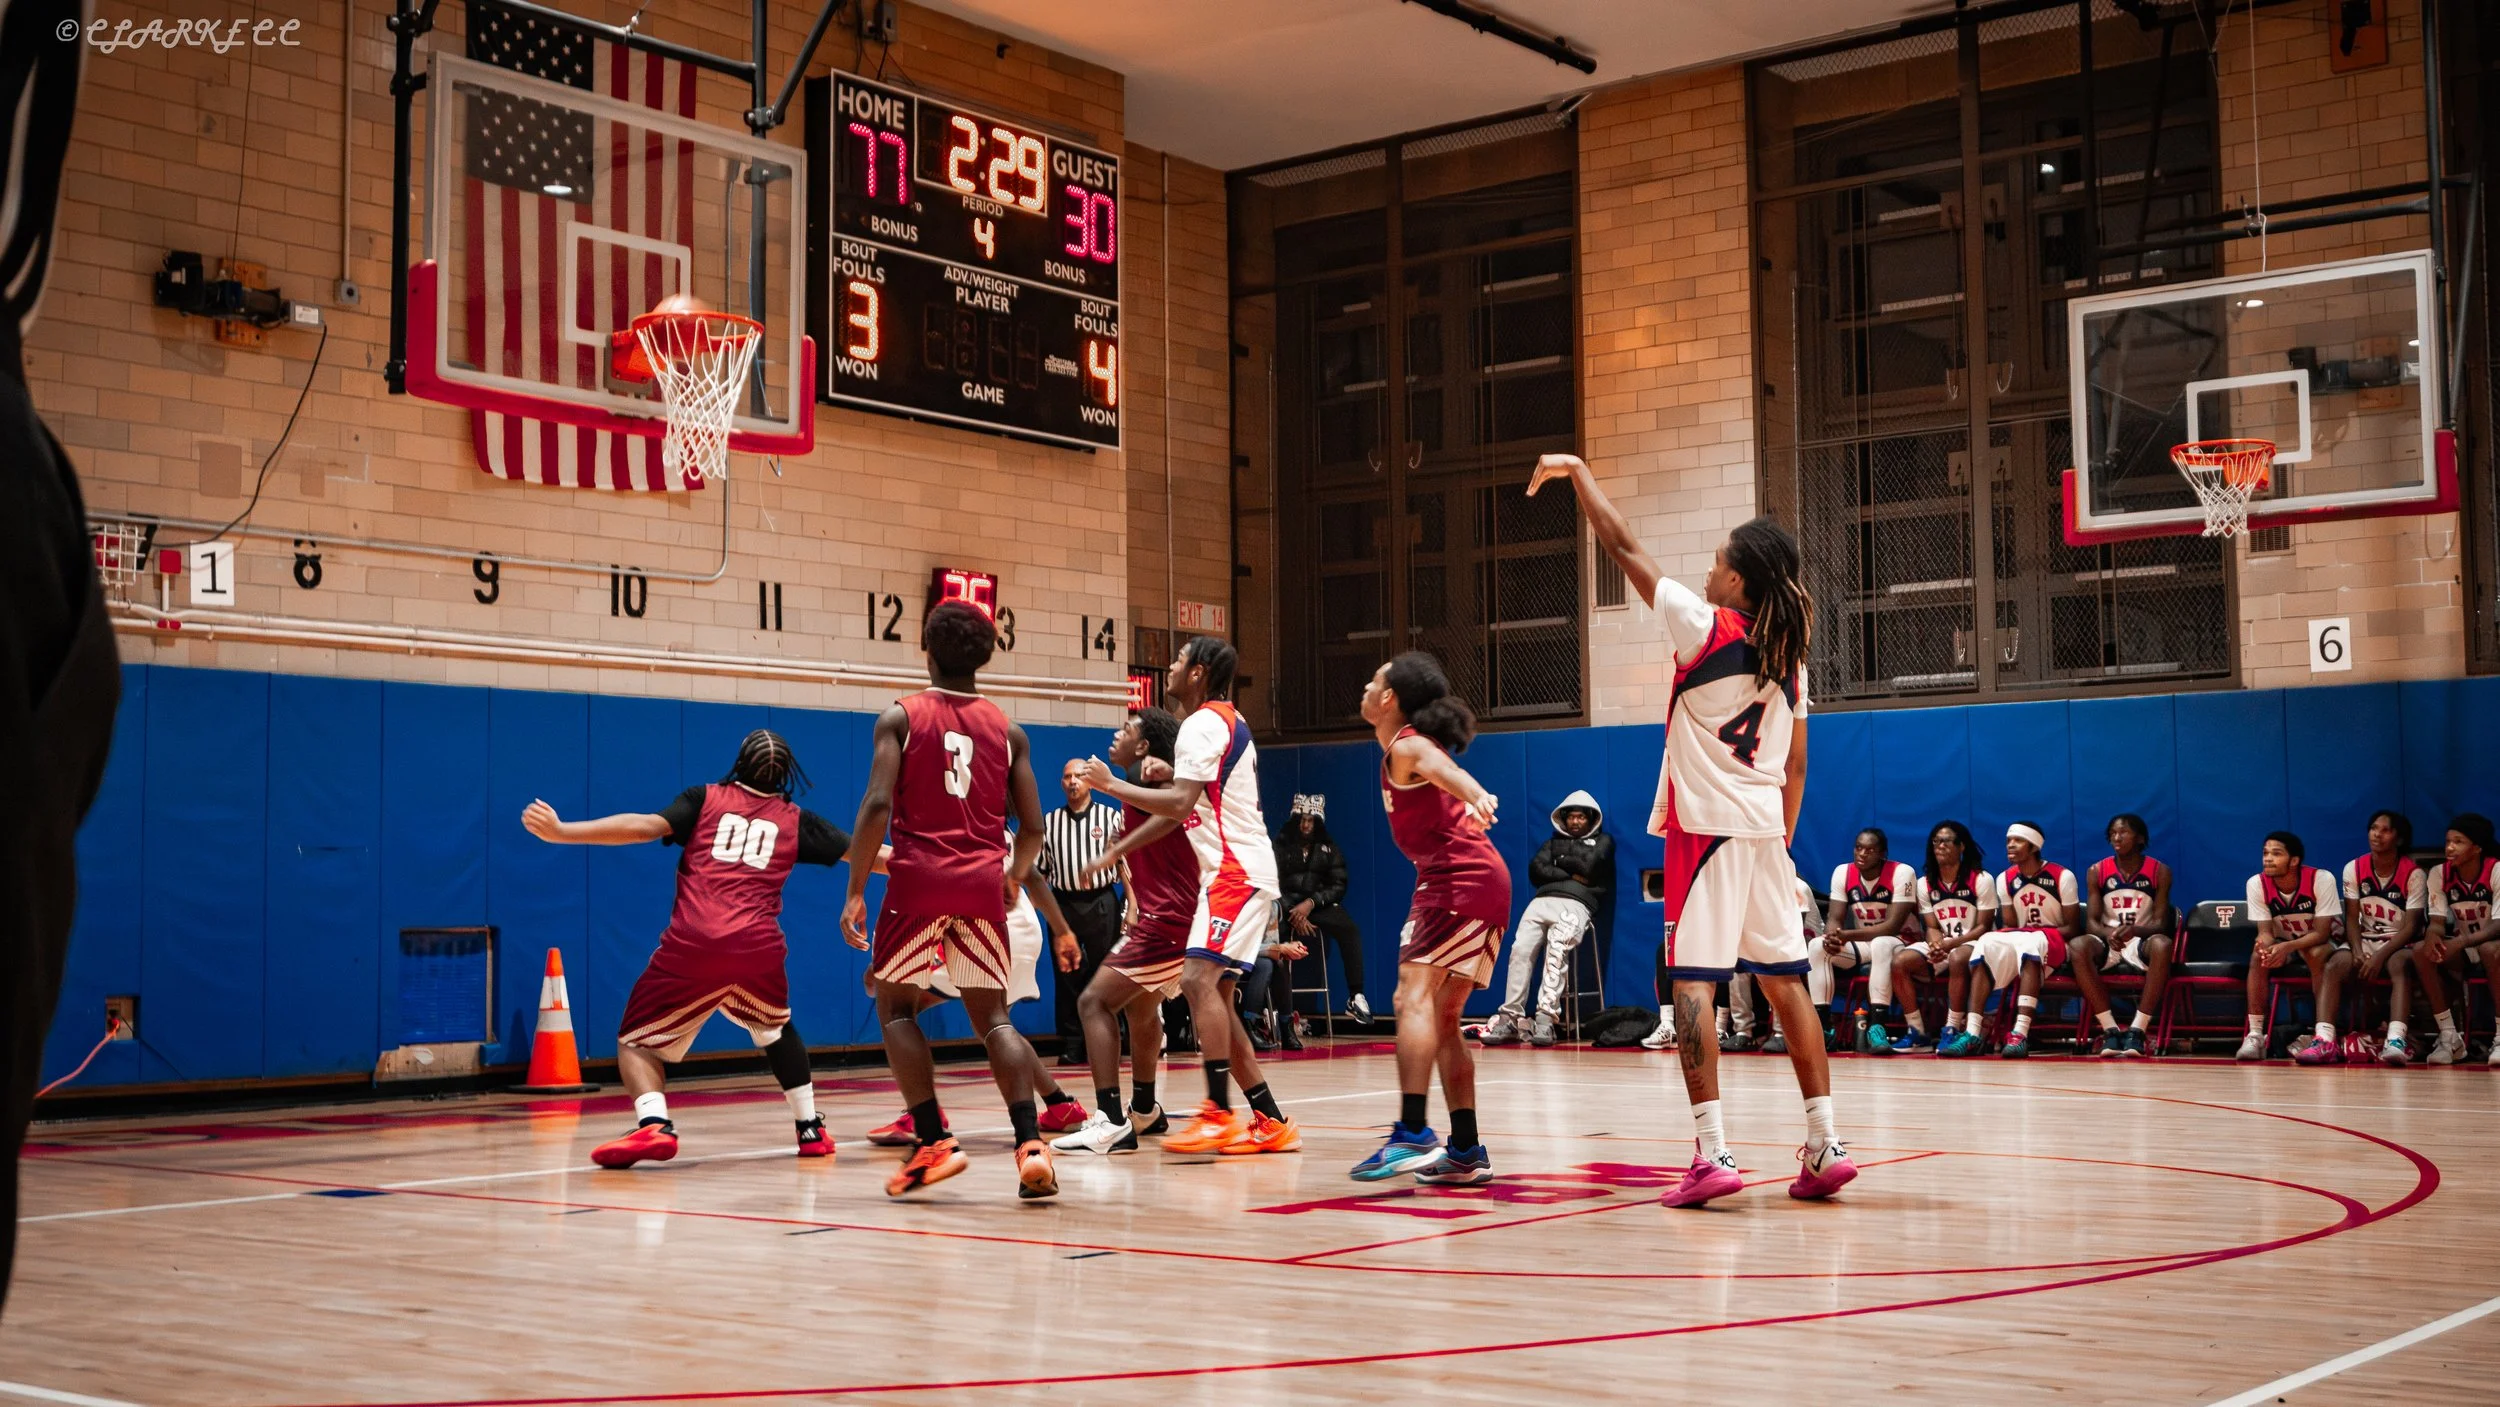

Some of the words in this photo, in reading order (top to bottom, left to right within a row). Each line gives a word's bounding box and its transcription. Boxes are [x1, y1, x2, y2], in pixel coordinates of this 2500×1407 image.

[838, 83, 905, 130] HOME
[849, 122, 907, 205] 77
[949, 115, 1045, 211] 2:29
[1053, 149, 1117, 191] GUEST
[962, 195, 1004, 217] PERIOD
[1065, 184, 1116, 265] 30
[871, 215, 919, 242] BONUS
[973, 217, 994, 260] 4
[833, 256, 886, 284] FOULS
[841, 240, 877, 262] BOUT
[1044, 259, 1086, 284] BONUS
[944, 265, 1019, 298] ADV./WEIGHT
[955, 286, 1010, 314] PLAYER
[849, 281, 879, 361] 3
[1074, 313, 1118, 338] FOULS
[1081, 299, 1111, 318] BOUT
[835, 355, 878, 381] WON
[1089, 340, 1116, 406] 4
[962, 381, 1004, 405] GAME
[1080, 405, 1116, 428] WON
[201, 551, 226, 594] 1
[473, 551, 500, 605] 9
[611, 564, 647, 618] 10
[759, 581, 782, 631] 11
[868, 592, 903, 642] 12
[1180, 600, 1203, 629] EXIT
[1213, 607, 1223, 630] 14
[1081, 614, 1117, 662] 14
[2318, 625, 2344, 664] 6
[1718, 701, 1767, 769] 4
[943, 730, 974, 799] 3
[711, 813, 779, 870] 00
[1946, 921, 1963, 938] 14
